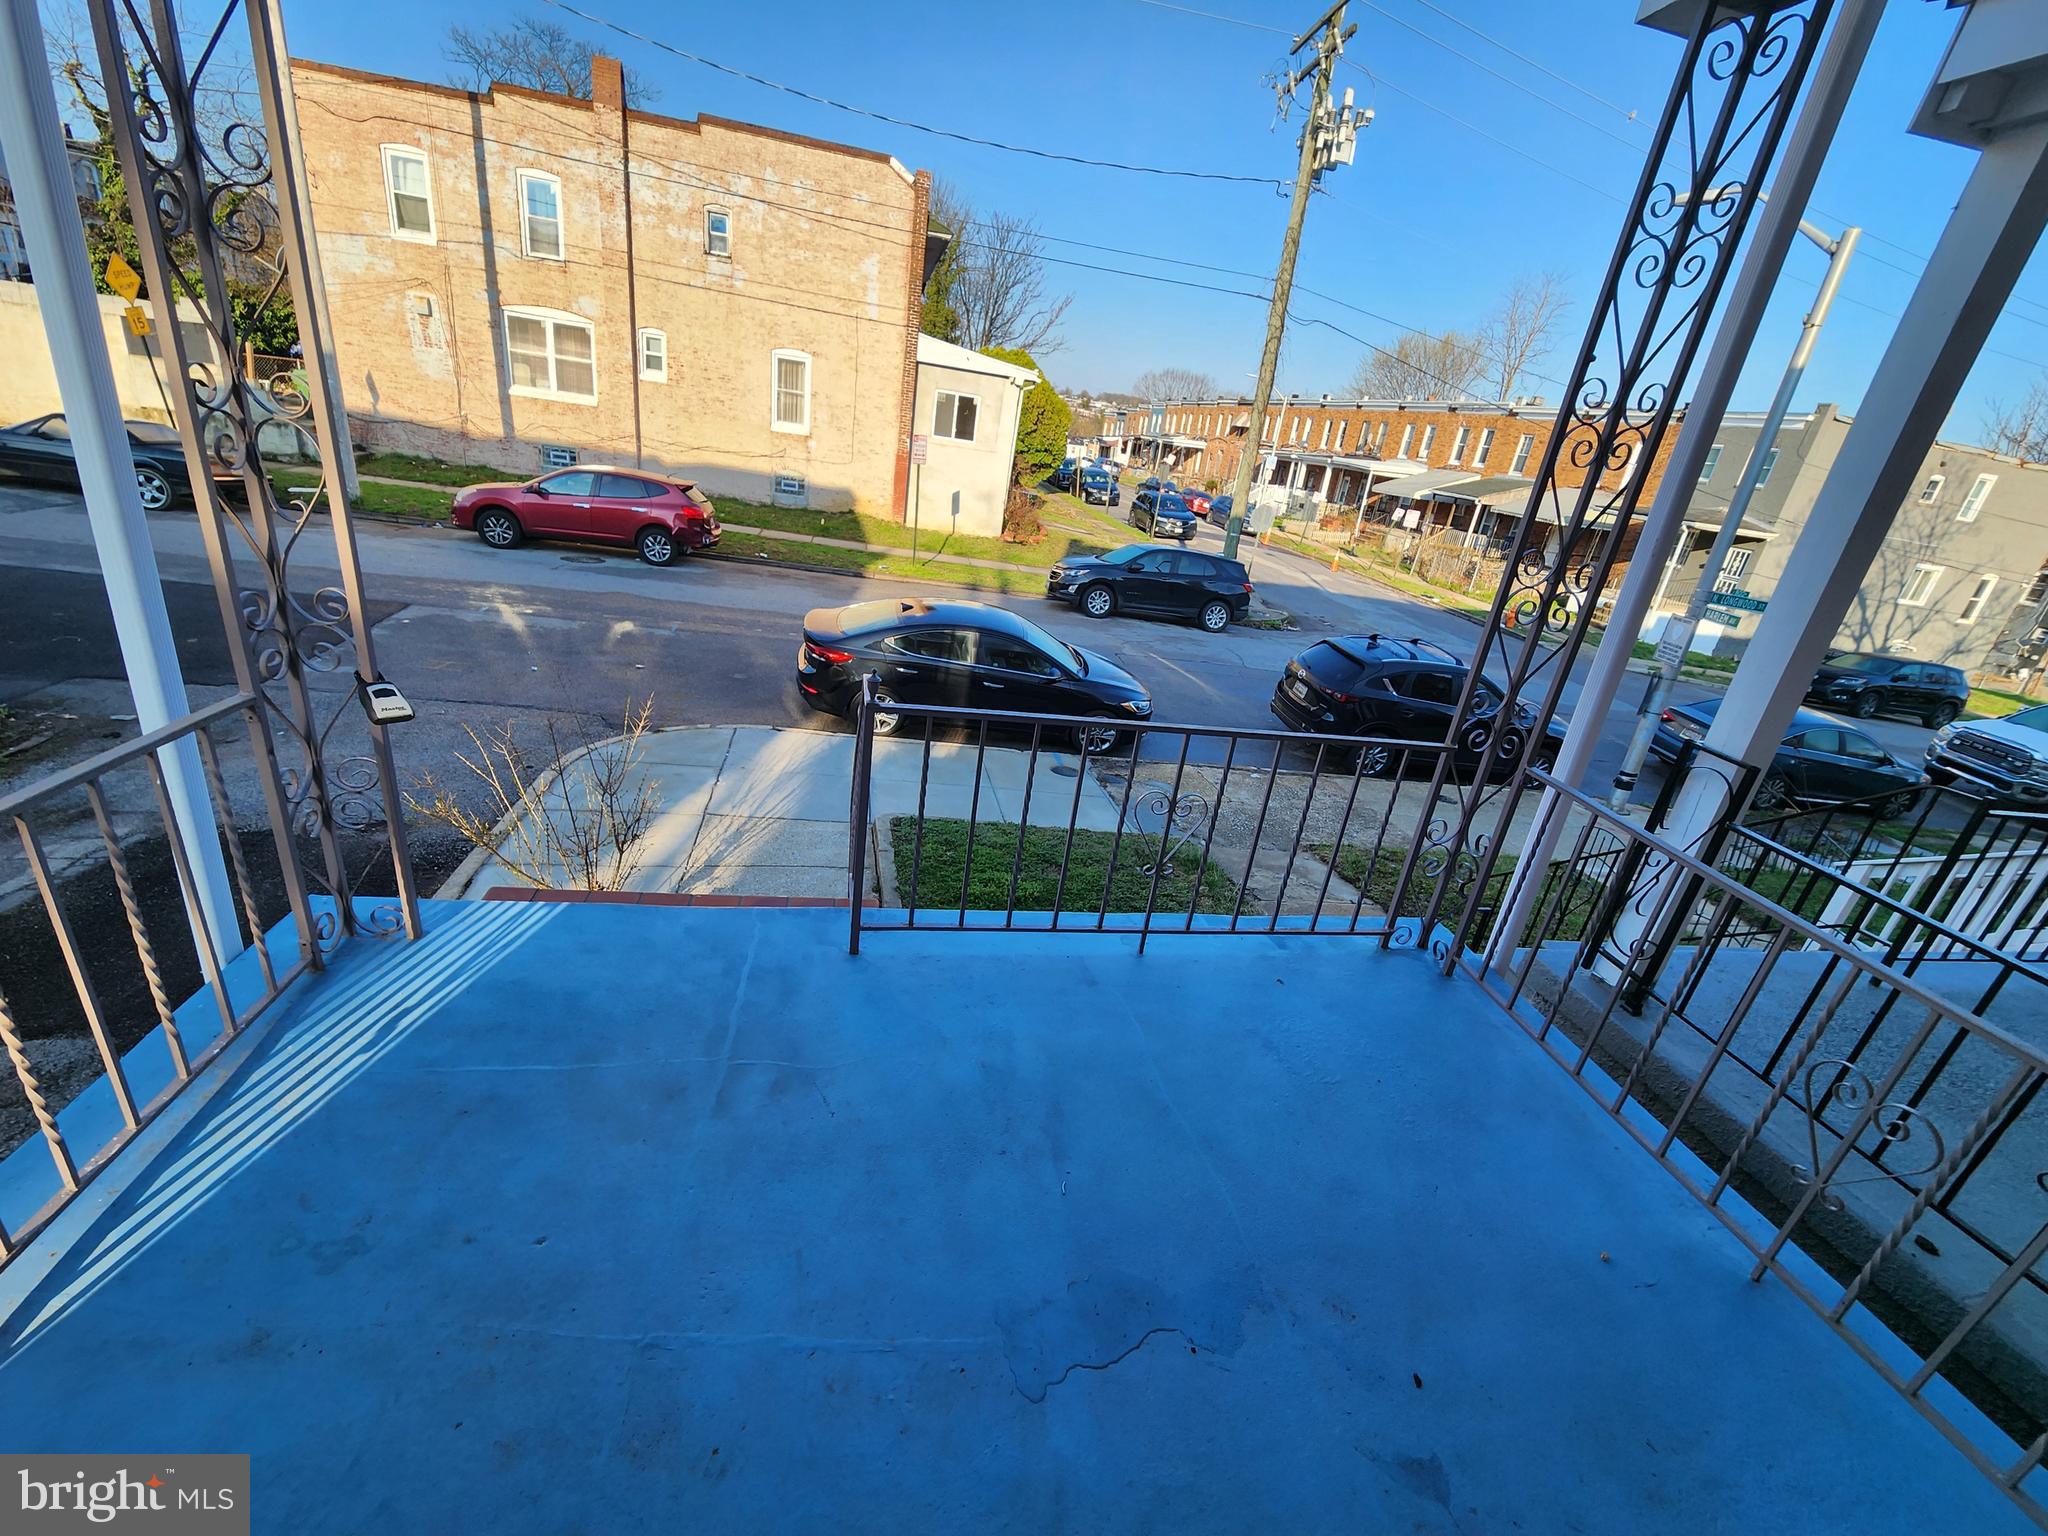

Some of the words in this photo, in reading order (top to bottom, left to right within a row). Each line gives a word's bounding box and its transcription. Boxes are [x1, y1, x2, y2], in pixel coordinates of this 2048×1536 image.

[132, 317, 146, 330] 15
[1720, 595, 1758, 610] LONGWOOD
[1705, 609, 1730, 624] HARLEM
